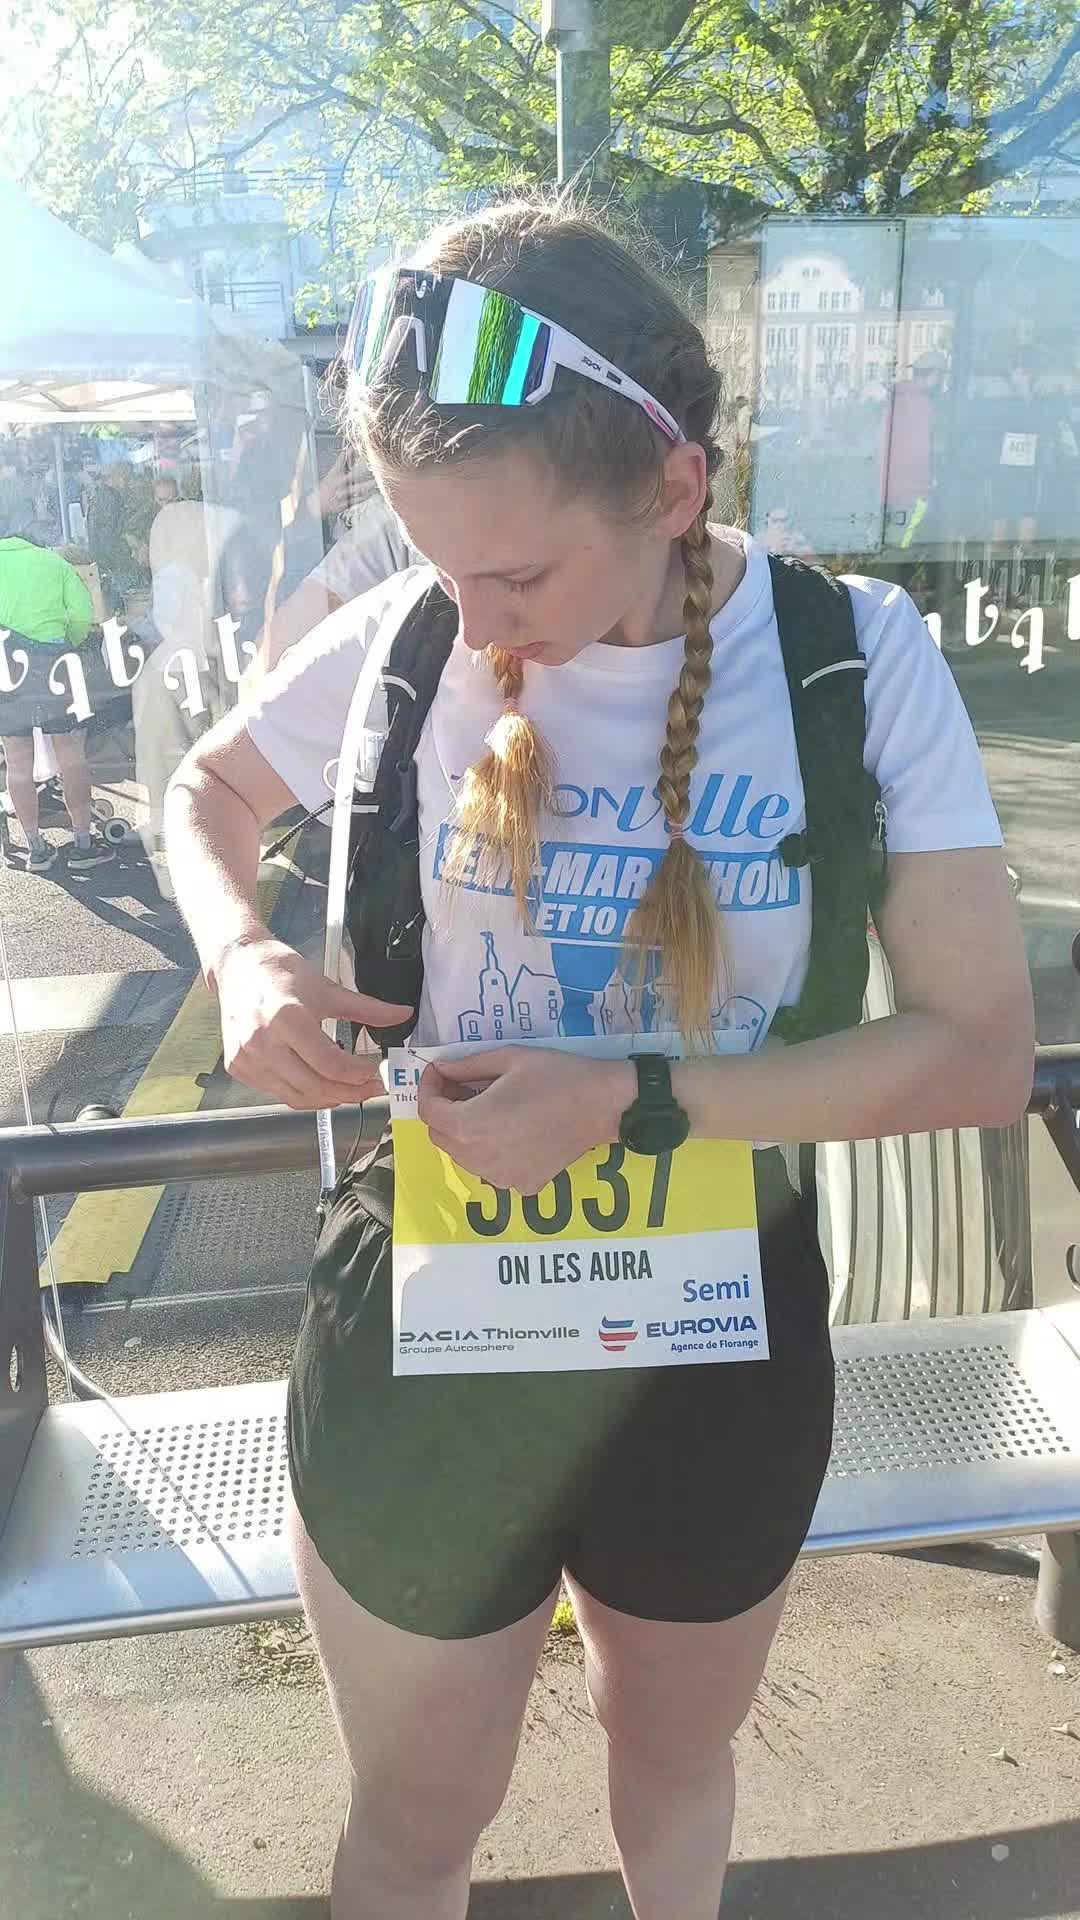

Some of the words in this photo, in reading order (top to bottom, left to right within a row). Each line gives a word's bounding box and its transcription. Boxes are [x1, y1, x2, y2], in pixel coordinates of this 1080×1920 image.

[536, 903, 577, 932] ET
[580, 905, 617, 936] 10
[498, 1255, 529, 1285] ON
[540, 1252, 581, 1283] LES
[589, 1249, 653, 1281] AURA
[683, 1274, 750, 1303] Semi
[400, 1330, 479, 1342] DACIA
[482, 1326, 580, 1340] Thionville
[646, 1315, 757, 1338] EUROVIA
[400, 1346, 442, 1355] Groupe
[444, 1343, 515, 1353] Autosphere
[671, 1343, 704, 1353] Agence
[706, 1340, 717, 1349] de
[719, 1338, 759, 1349] Florange
